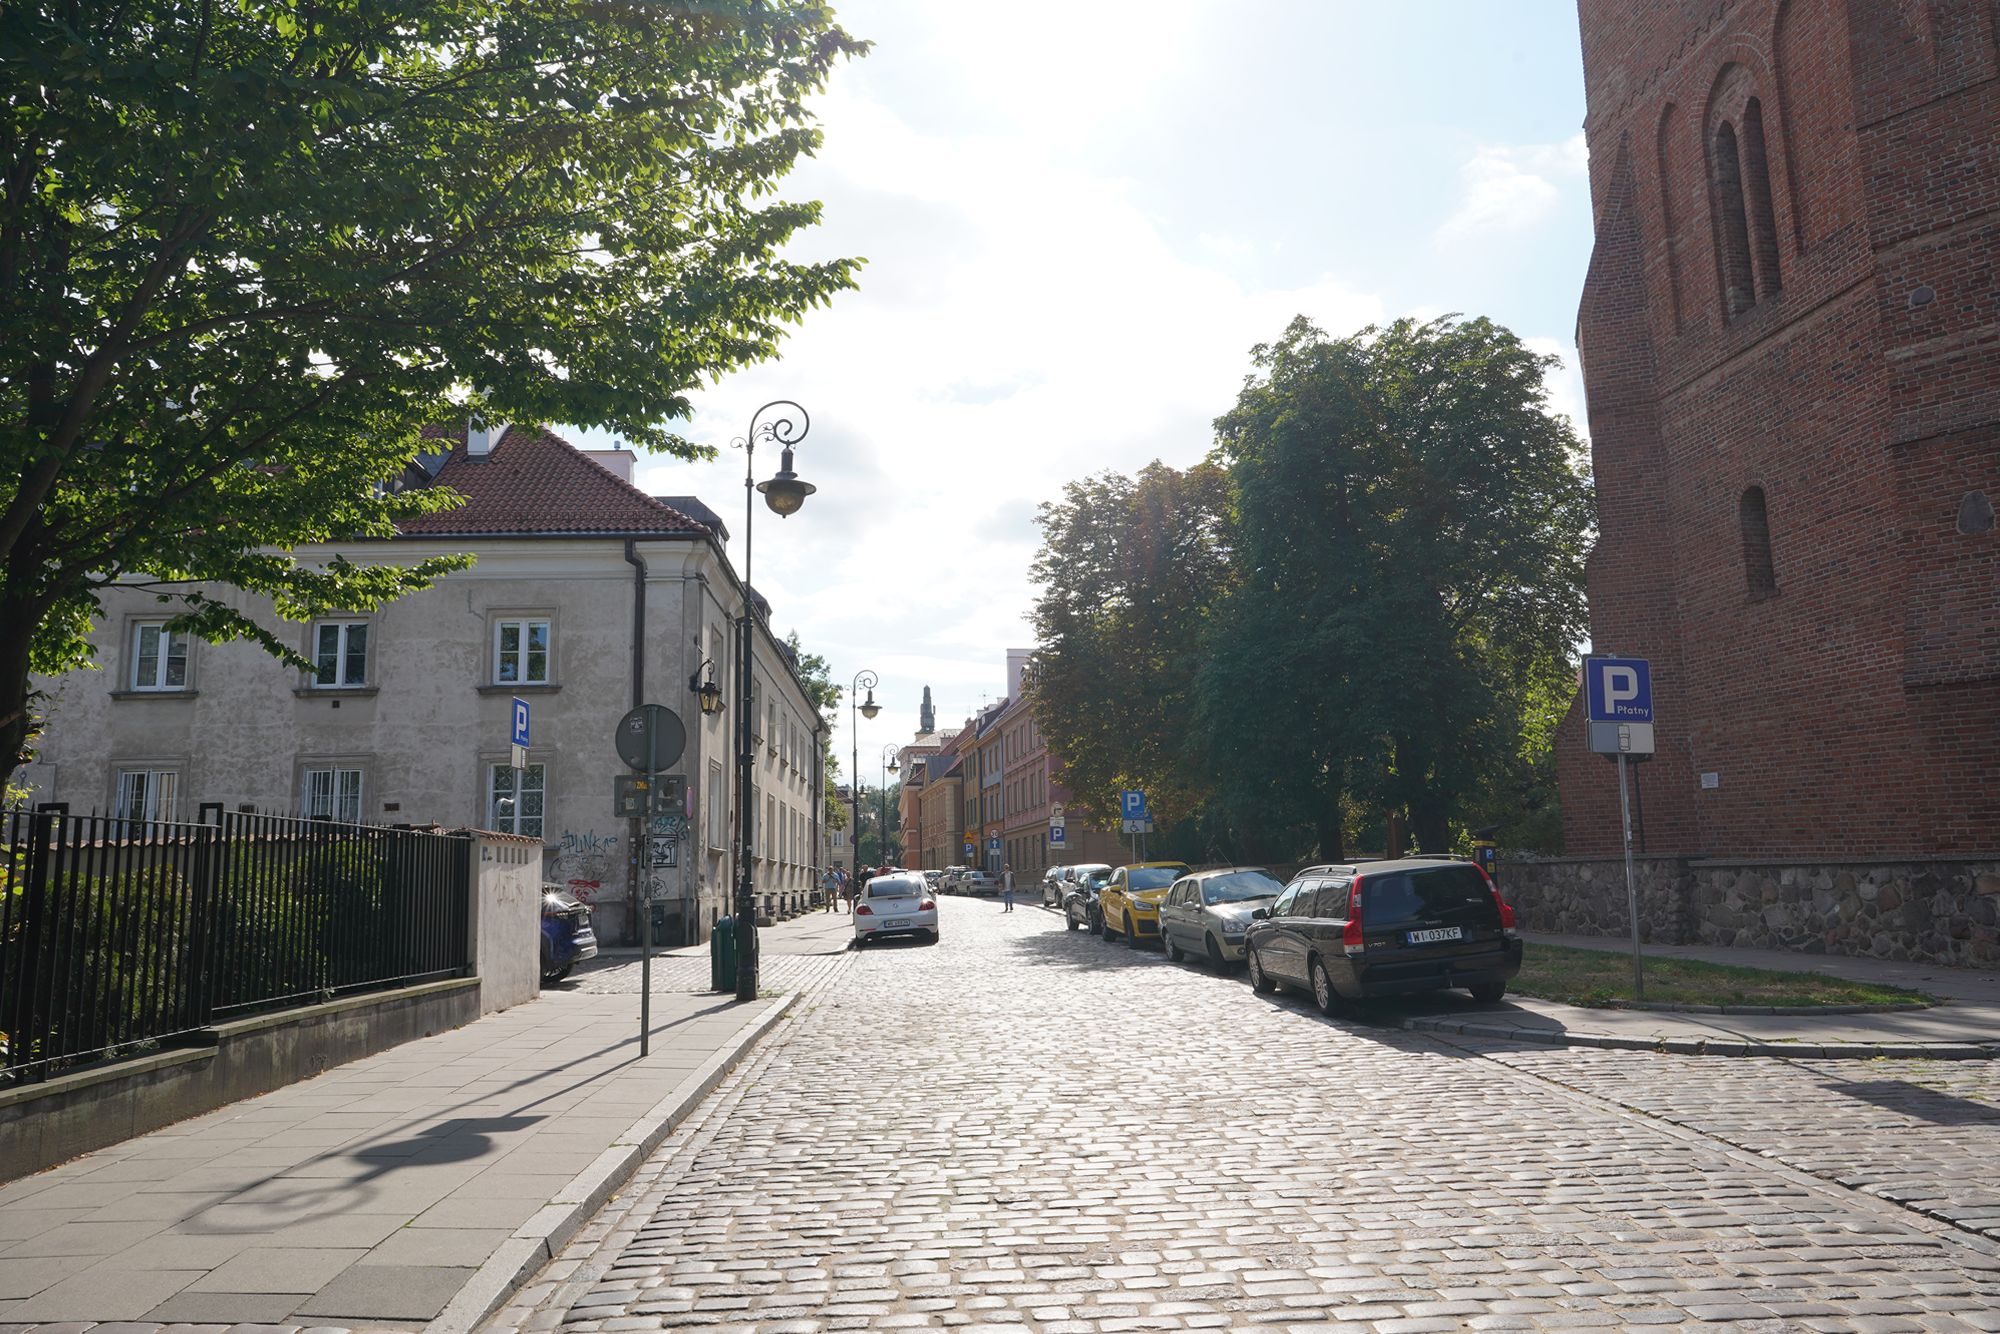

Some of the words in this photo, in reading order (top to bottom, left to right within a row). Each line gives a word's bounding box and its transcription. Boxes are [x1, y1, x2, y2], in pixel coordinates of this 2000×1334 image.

[1602, 666, 1638, 714] P
[1617, 705, 1649, 718] Płatny
[515, 704, 527, 740] P
[1127, 793, 1140, 811] P
[1053, 828, 1062, 840] P
[965, 843, 972, 851] P
[1412, 931, 1425, 942] WI
[1428, 928, 1459, 941] 037KF
